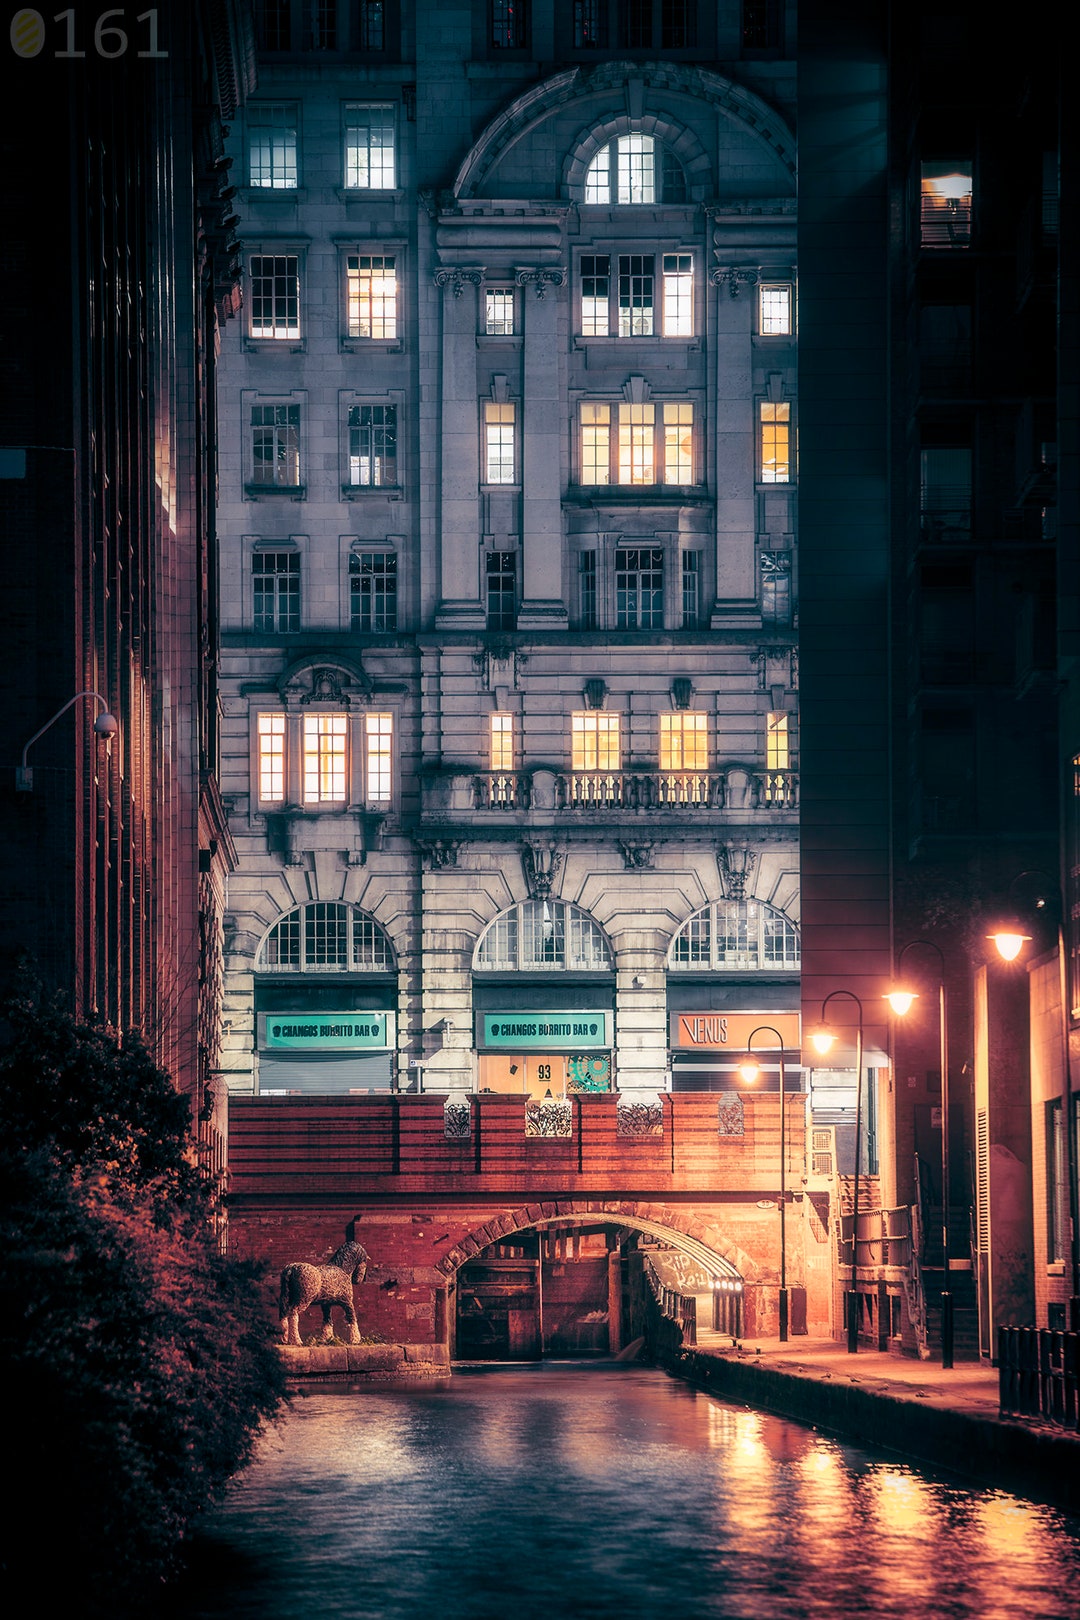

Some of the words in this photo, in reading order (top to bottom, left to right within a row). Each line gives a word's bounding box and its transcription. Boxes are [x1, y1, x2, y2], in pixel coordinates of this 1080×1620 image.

[282, 1025, 318, 1037] CHANGOS
[320, 1025, 353, 1037] BURRITO
[354, 1025, 370, 1037] BAR
[501, 1024, 536, 1036] CHANGOS
[538, 1024, 571, 1036] BURRITO
[573, 1024, 588, 1036] BAR
[682, 1018, 728, 1043] VENUS
[538, 1064, 551, 1079] 93
